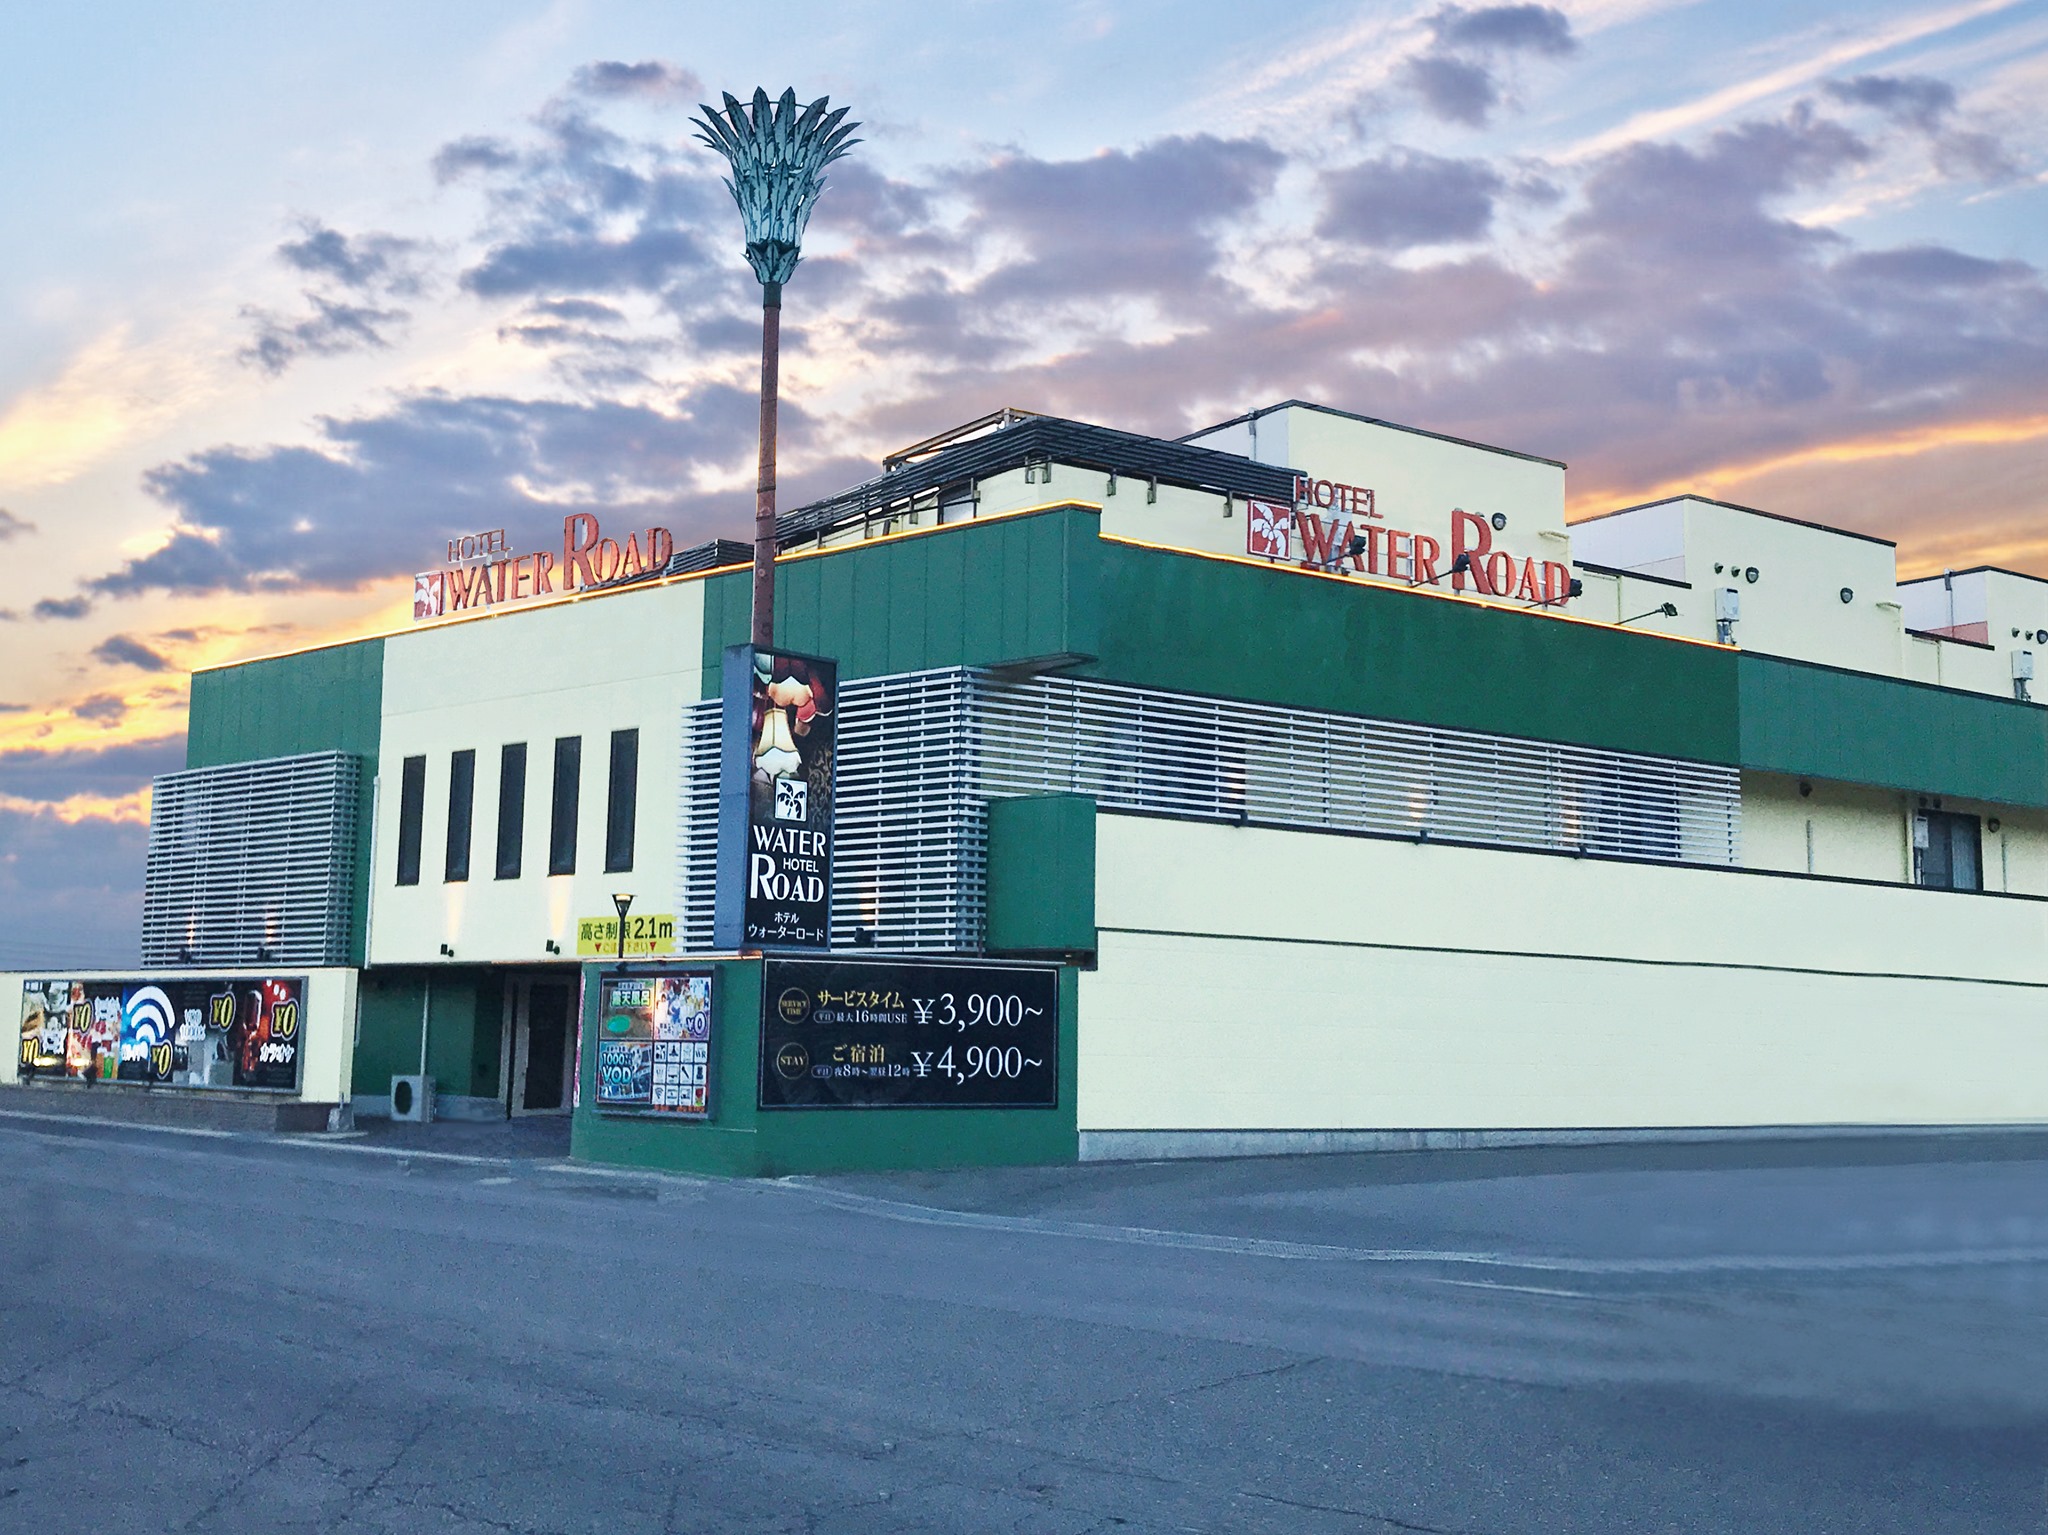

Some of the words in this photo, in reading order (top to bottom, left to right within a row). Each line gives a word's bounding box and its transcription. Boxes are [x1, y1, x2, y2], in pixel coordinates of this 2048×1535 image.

[1294, 476, 1383, 519] HOTEL
[448, 528, 512, 562] HOTEL
[446, 552, 554, 611] WATER
[563, 513, 673, 590] ROAD
[1296, 511, 1440, 586] WATER
[1452, 509, 1571, 607] ROAD
[753, 825, 827, 857] WATER
[783, 857, 819, 873] HOTEL
[750, 853, 825, 903] ROAD
[774, 911, 800, 925] ホテル
[748, 923, 824, 941] ウォーターロード
[817, 989, 905, 1009] サービスタイム
[780, 1055, 806, 1065] STAY
[832, 1043, 885, 1063] ご宿泊
[602, 1065, 632, 1085] VOD
